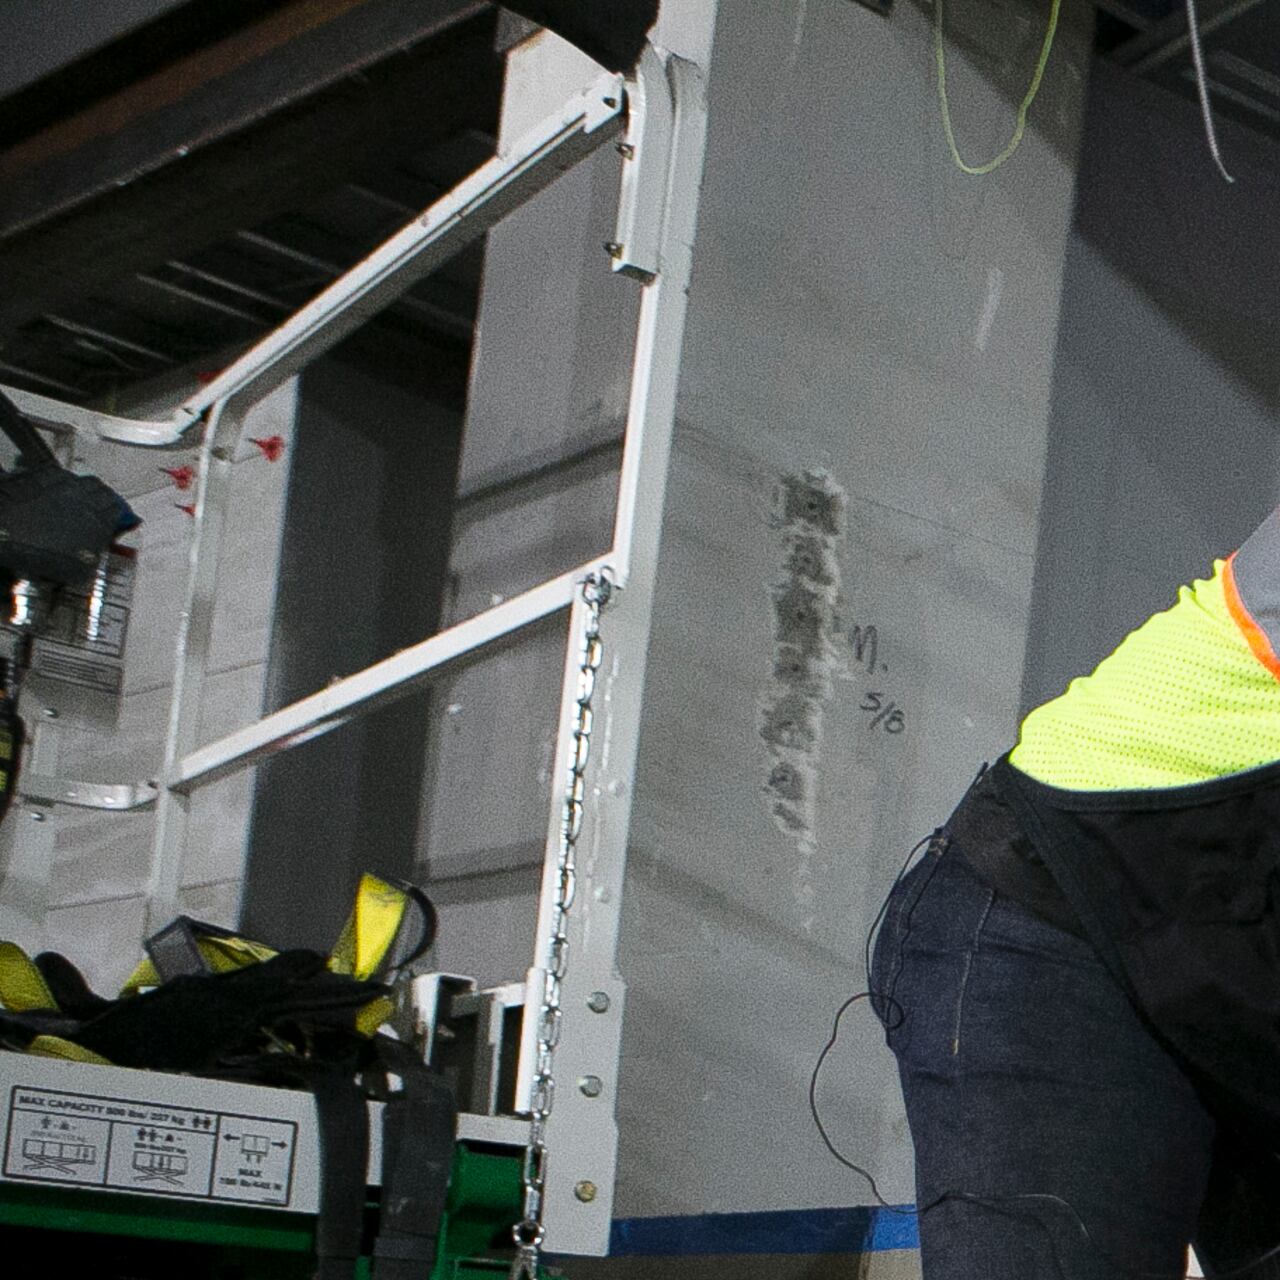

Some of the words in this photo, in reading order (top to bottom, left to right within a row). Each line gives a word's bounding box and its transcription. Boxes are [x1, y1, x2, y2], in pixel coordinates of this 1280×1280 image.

[860, 692, 905, 734] 5/8
[19, 1095, 46, 1108] MAX
[48, 1098, 104, 1114] CAPACITY
